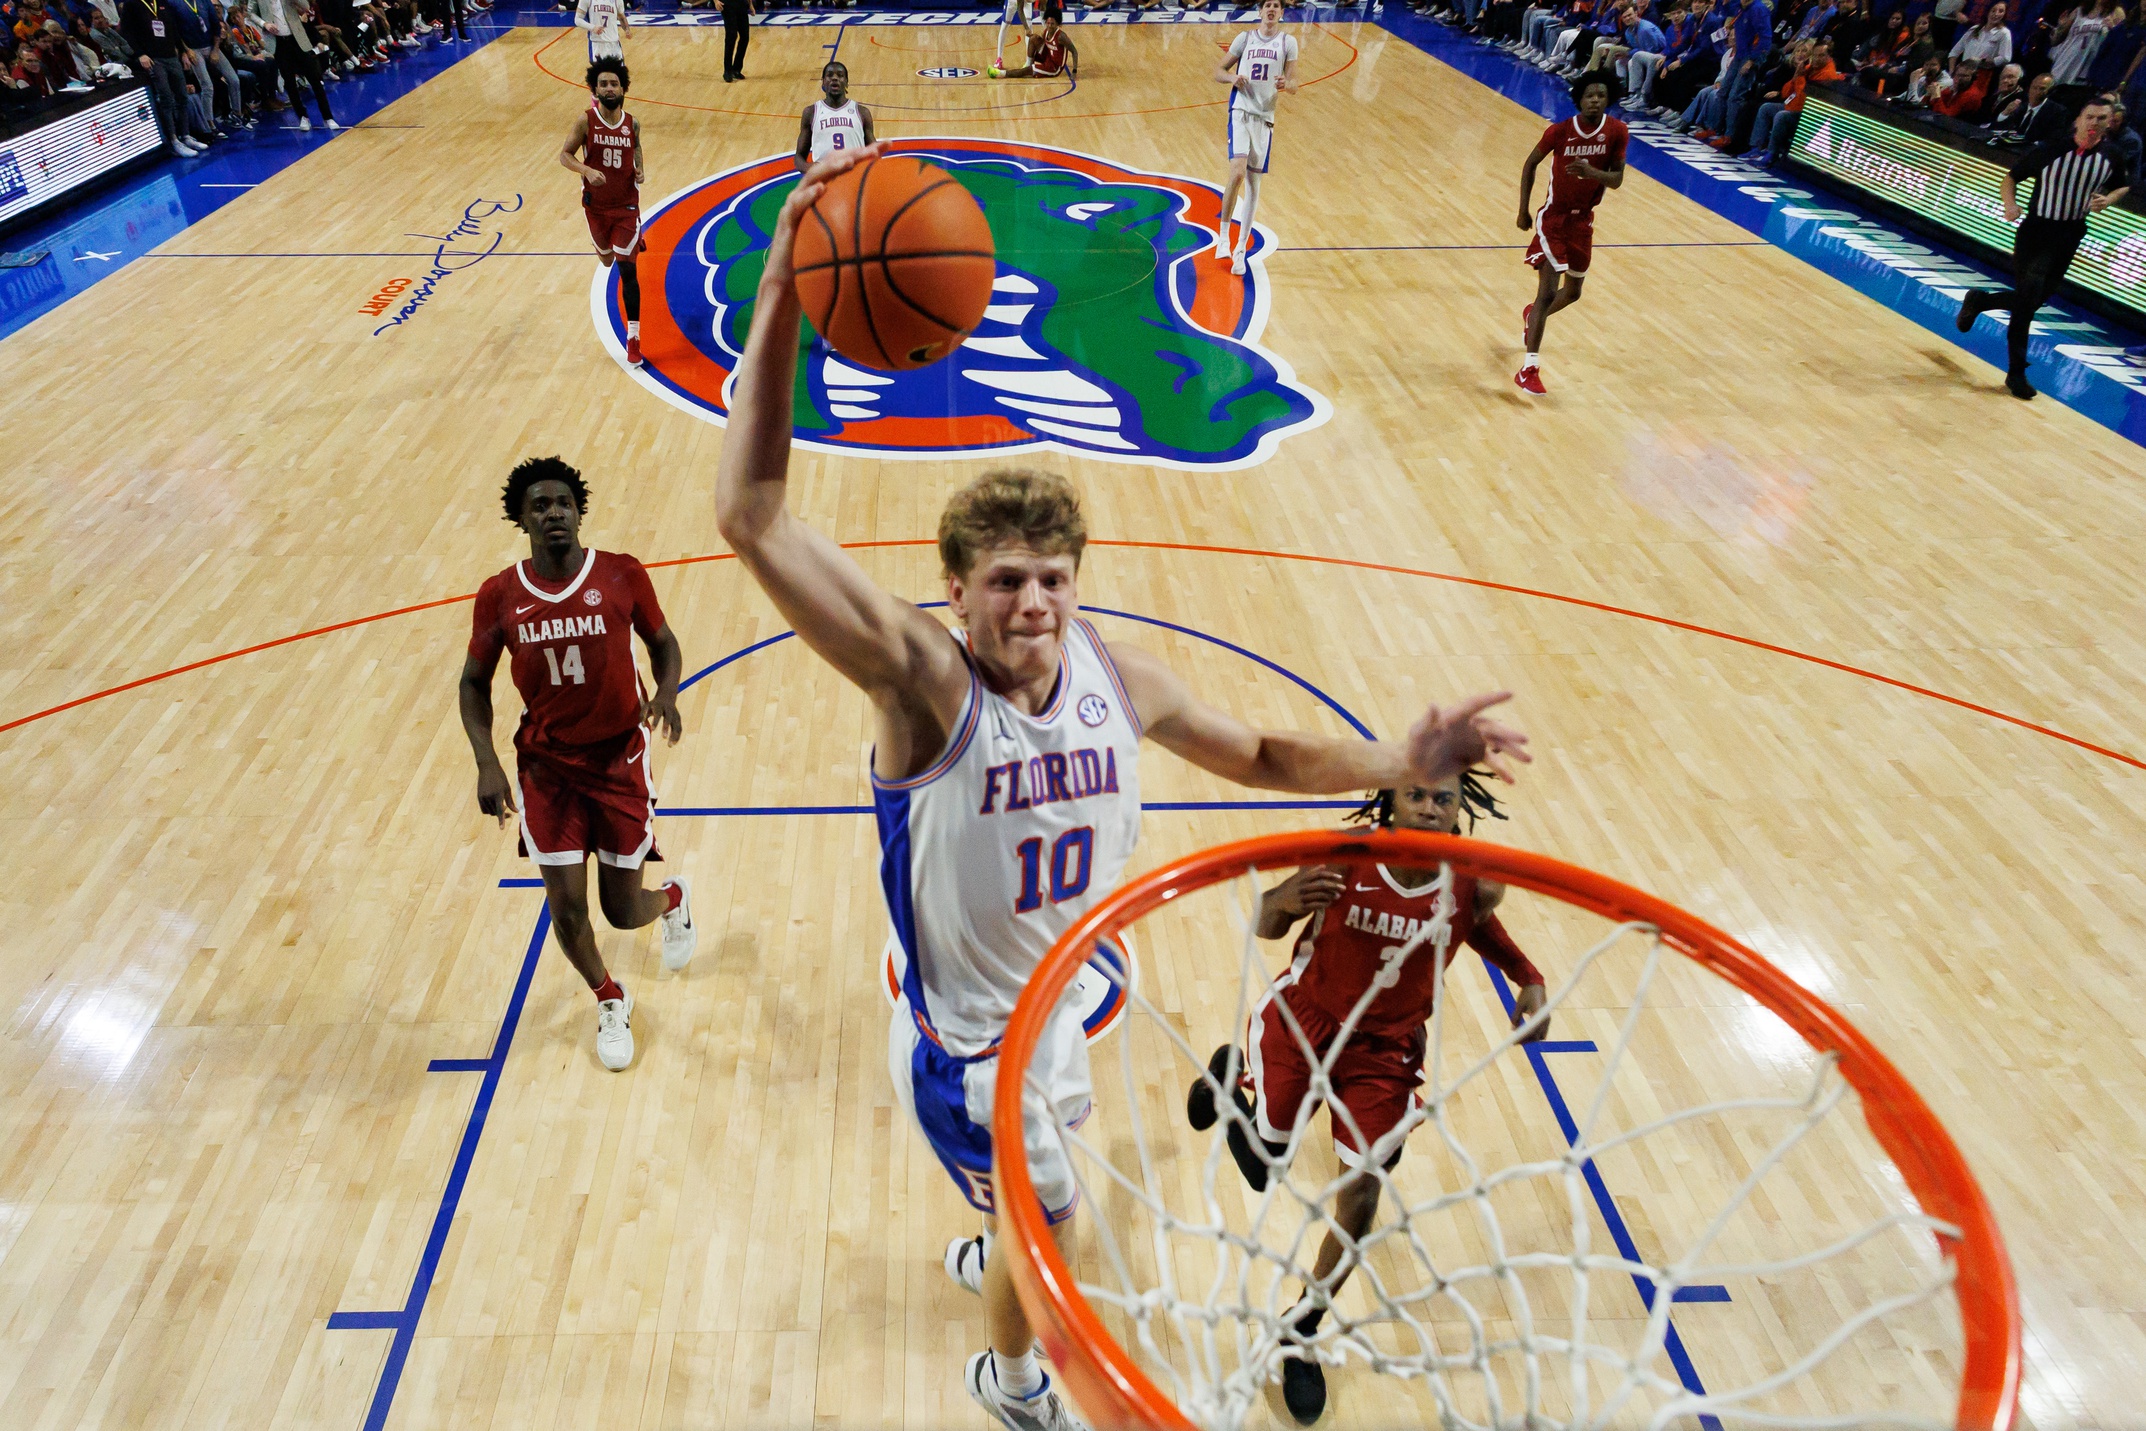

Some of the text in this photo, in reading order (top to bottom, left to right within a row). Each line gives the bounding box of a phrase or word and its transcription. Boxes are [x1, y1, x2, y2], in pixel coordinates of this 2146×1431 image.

[601, 15, 609, 28] 7
[1247, 49, 1278, 61] FLORIDA
[922, 68, 977, 78] SEC
[1251, 63, 1269, 81] 21
[820, 117, 854, 130] FLORIDA
[593, 134, 631, 147] ALABAMA
[832, 133, 845, 150] 9
[602, 148, 622, 169] 95
[1563, 144, 1606, 156] ALABAMA
[357, 278, 413, 317] COURT
[584, 589, 602, 606] SEC
[517, 614, 607, 643] ALABAMA
[543, 645, 586, 686] 14
[979, 746, 1120, 815] FLORIDA
[1015, 825, 1094, 915] 10
